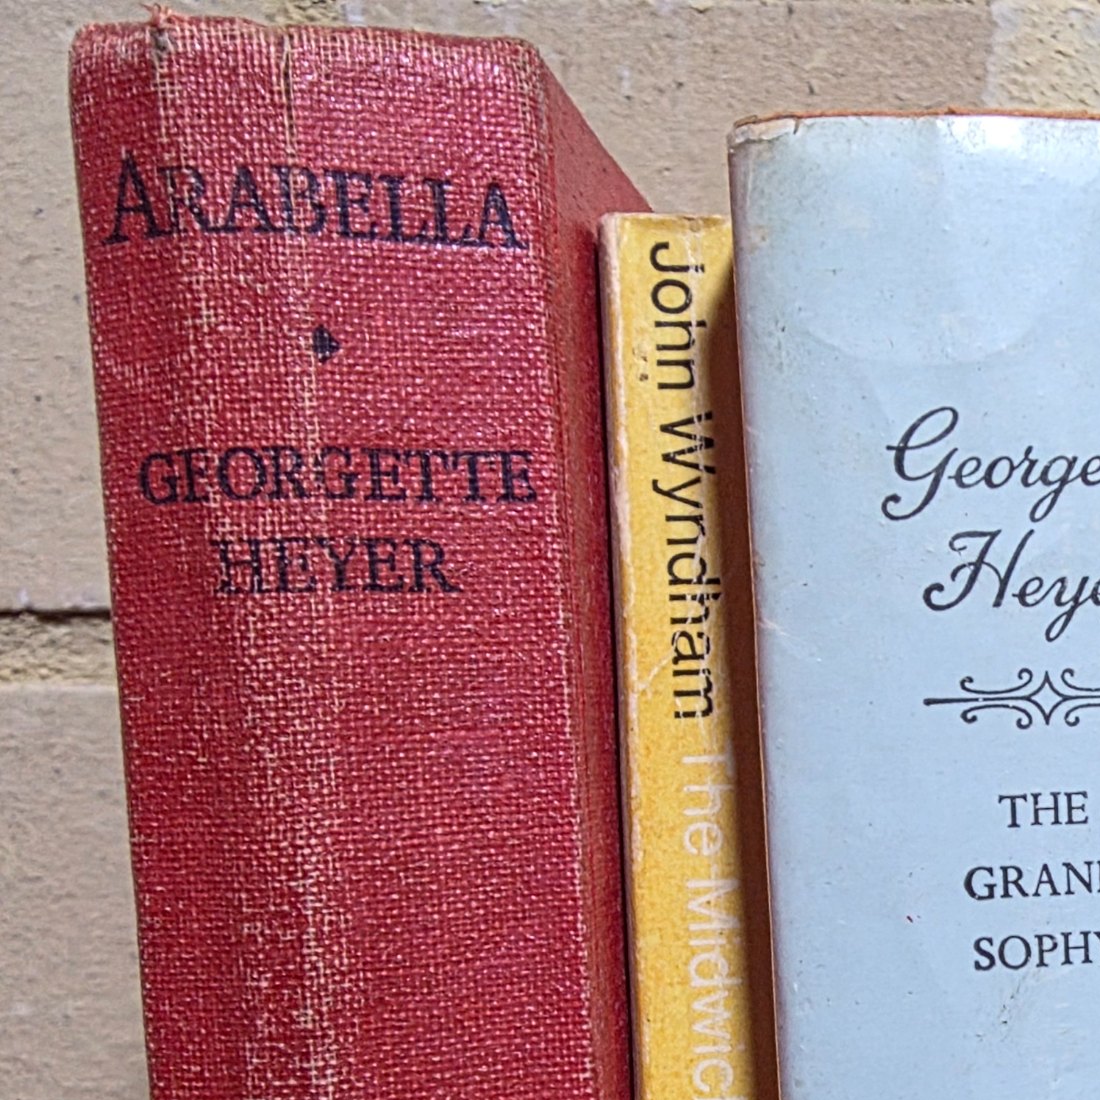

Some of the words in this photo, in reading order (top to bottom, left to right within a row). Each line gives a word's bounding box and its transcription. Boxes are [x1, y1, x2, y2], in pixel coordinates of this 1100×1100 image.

[102, 149, 532, 250] ARABELLA
[649, 240, 707, 391] John
[138, 445, 538, 506] GEORGETTE
[211, 536, 463, 595] HEYER
[652, 411, 723, 720] Wyndham
[682, 753, 734, 858] The
[997, 790, 1090, 829] THE
